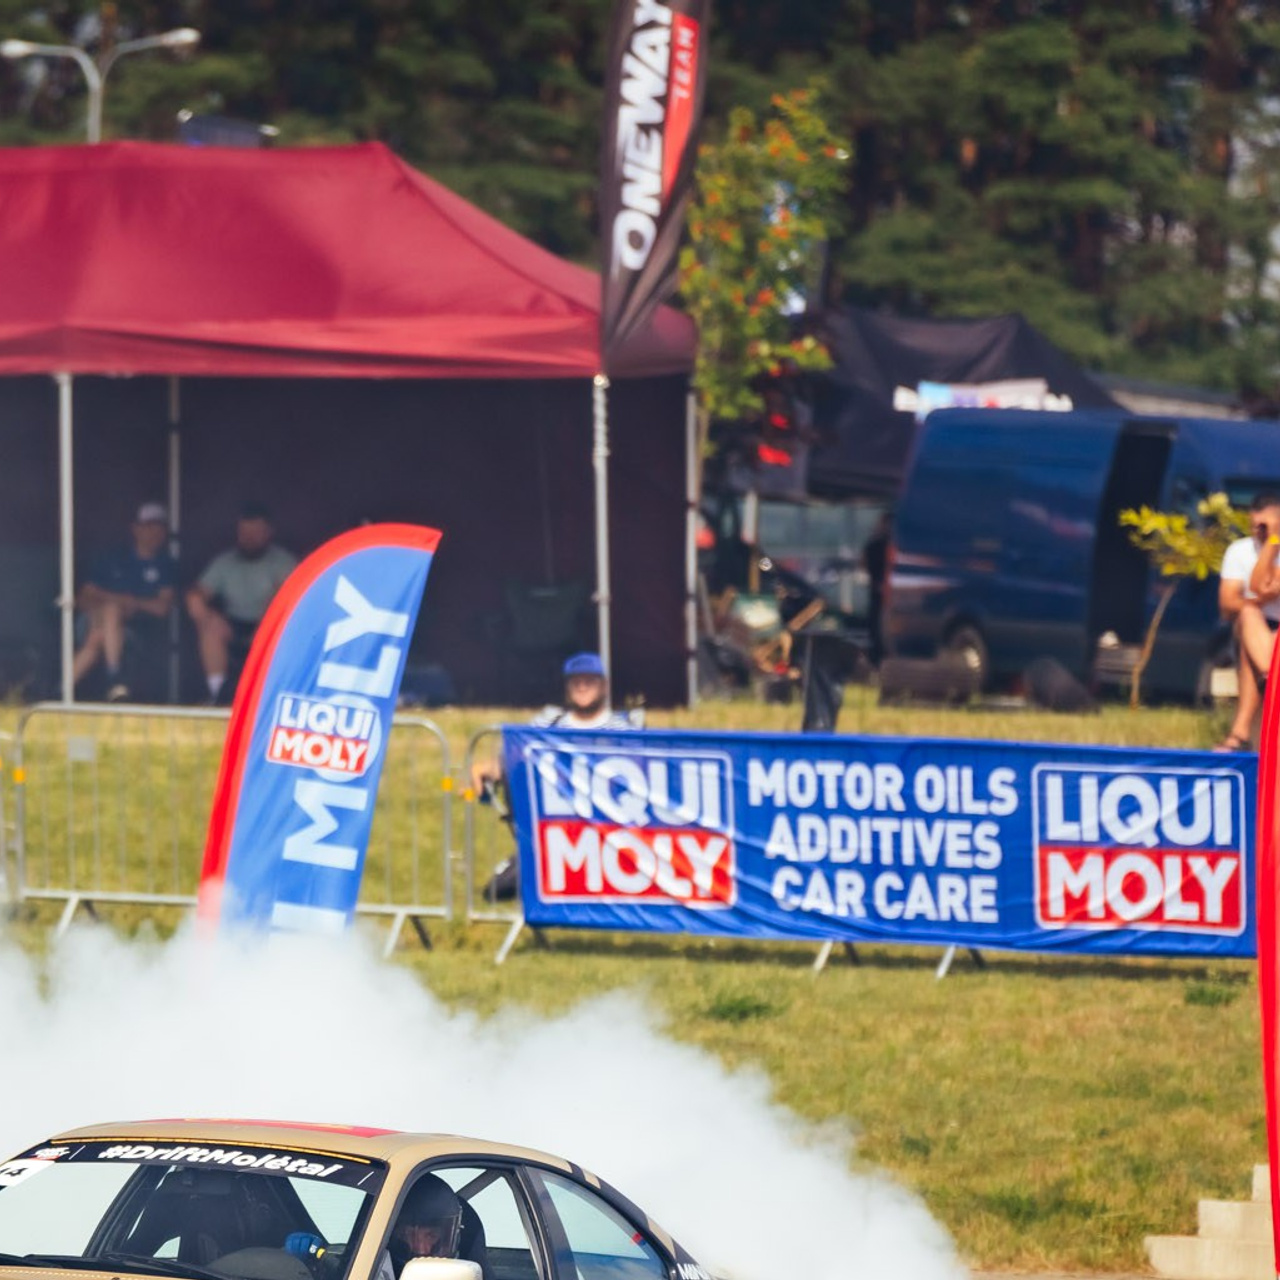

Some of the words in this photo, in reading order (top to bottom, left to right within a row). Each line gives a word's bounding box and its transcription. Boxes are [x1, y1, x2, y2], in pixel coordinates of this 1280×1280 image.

[671, 26, 696, 101] TEAM
[612, 0, 673, 270] ONEWAY
[271, 728, 370, 776] MOLY
[279, 696, 376, 740] LIQUI
[538, 752, 720, 828] LIQUI
[748, 758, 906, 812] MOTOR
[914, 764, 1018, 817] OILS
[1046, 773, 1232, 848] LIQUI
[545, 825, 728, 898] MOLY
[765, 813, 1002, 870] ADDITIVES
[773, 866, 867, 918] CAR
[873, 871, 999, 924] CARE
[1048, 852, 1238, 923] MOLY
